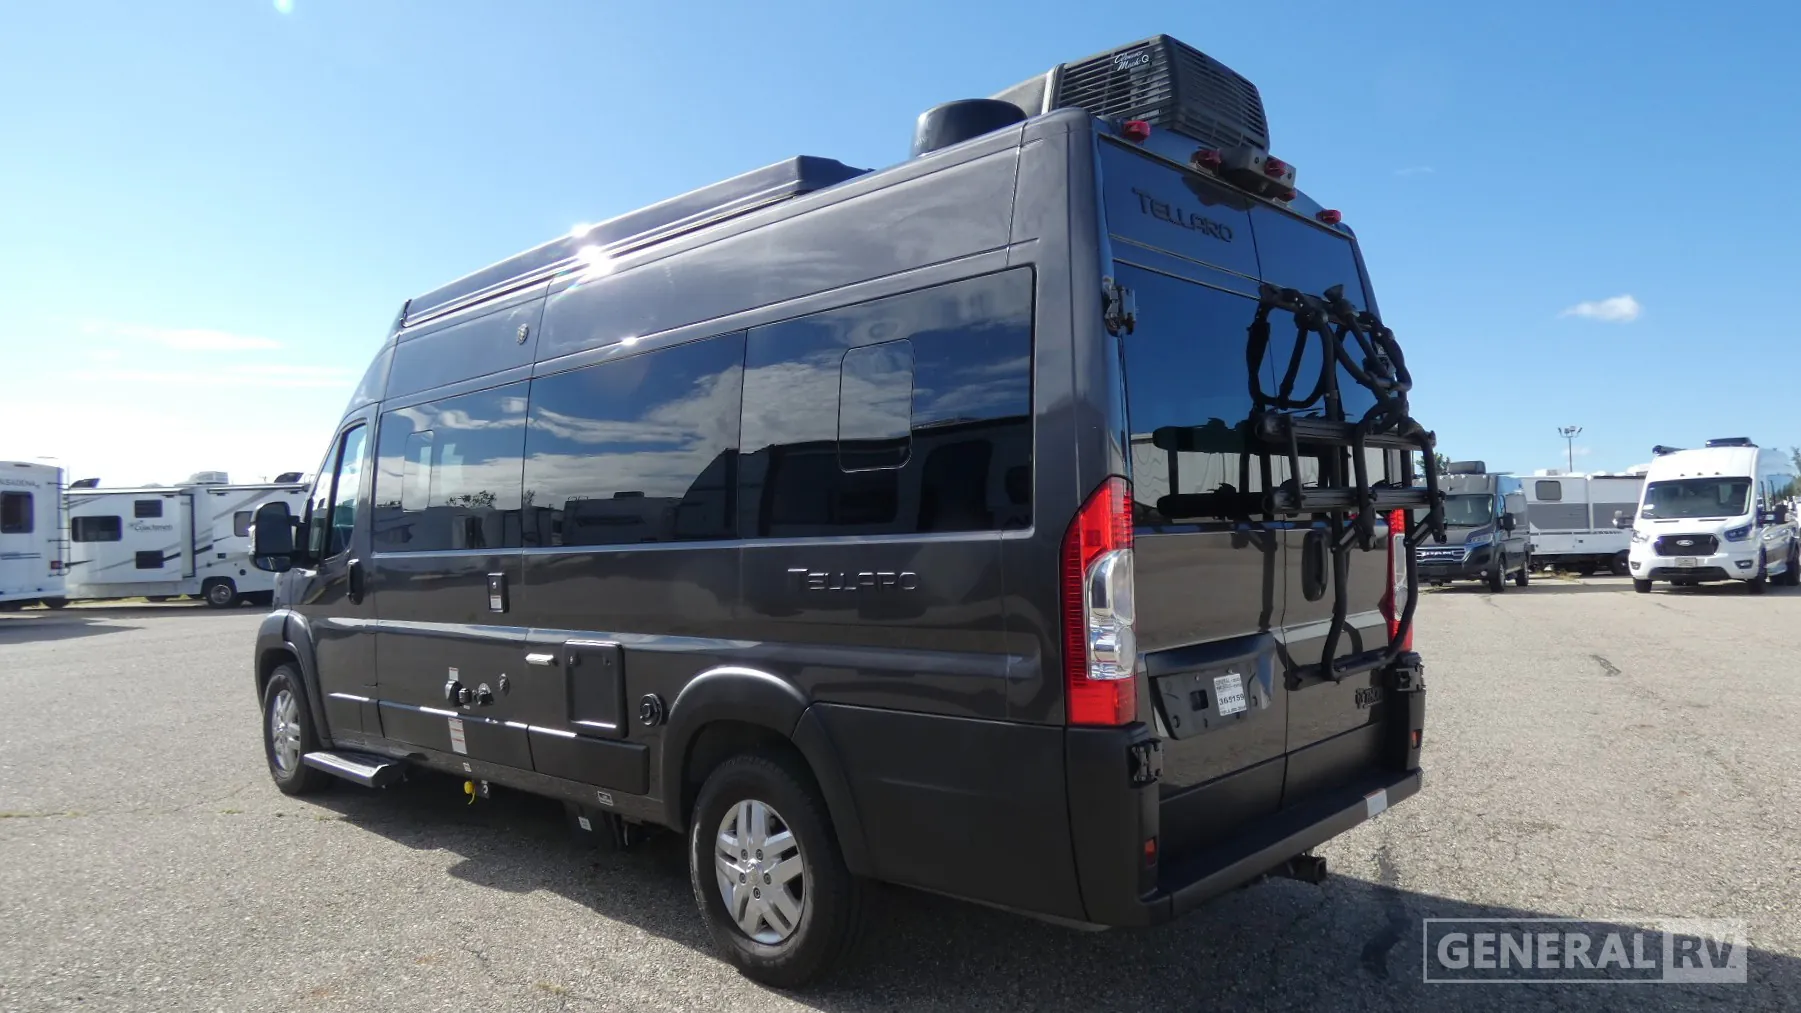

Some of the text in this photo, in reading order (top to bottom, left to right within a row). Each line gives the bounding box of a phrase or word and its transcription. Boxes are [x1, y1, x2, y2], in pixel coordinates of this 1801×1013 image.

[1131, 187, 1233, 243] TELLARO
[787, 567, 918, 593] TELLARO
[1219, 693, 1245, 706] 365159
